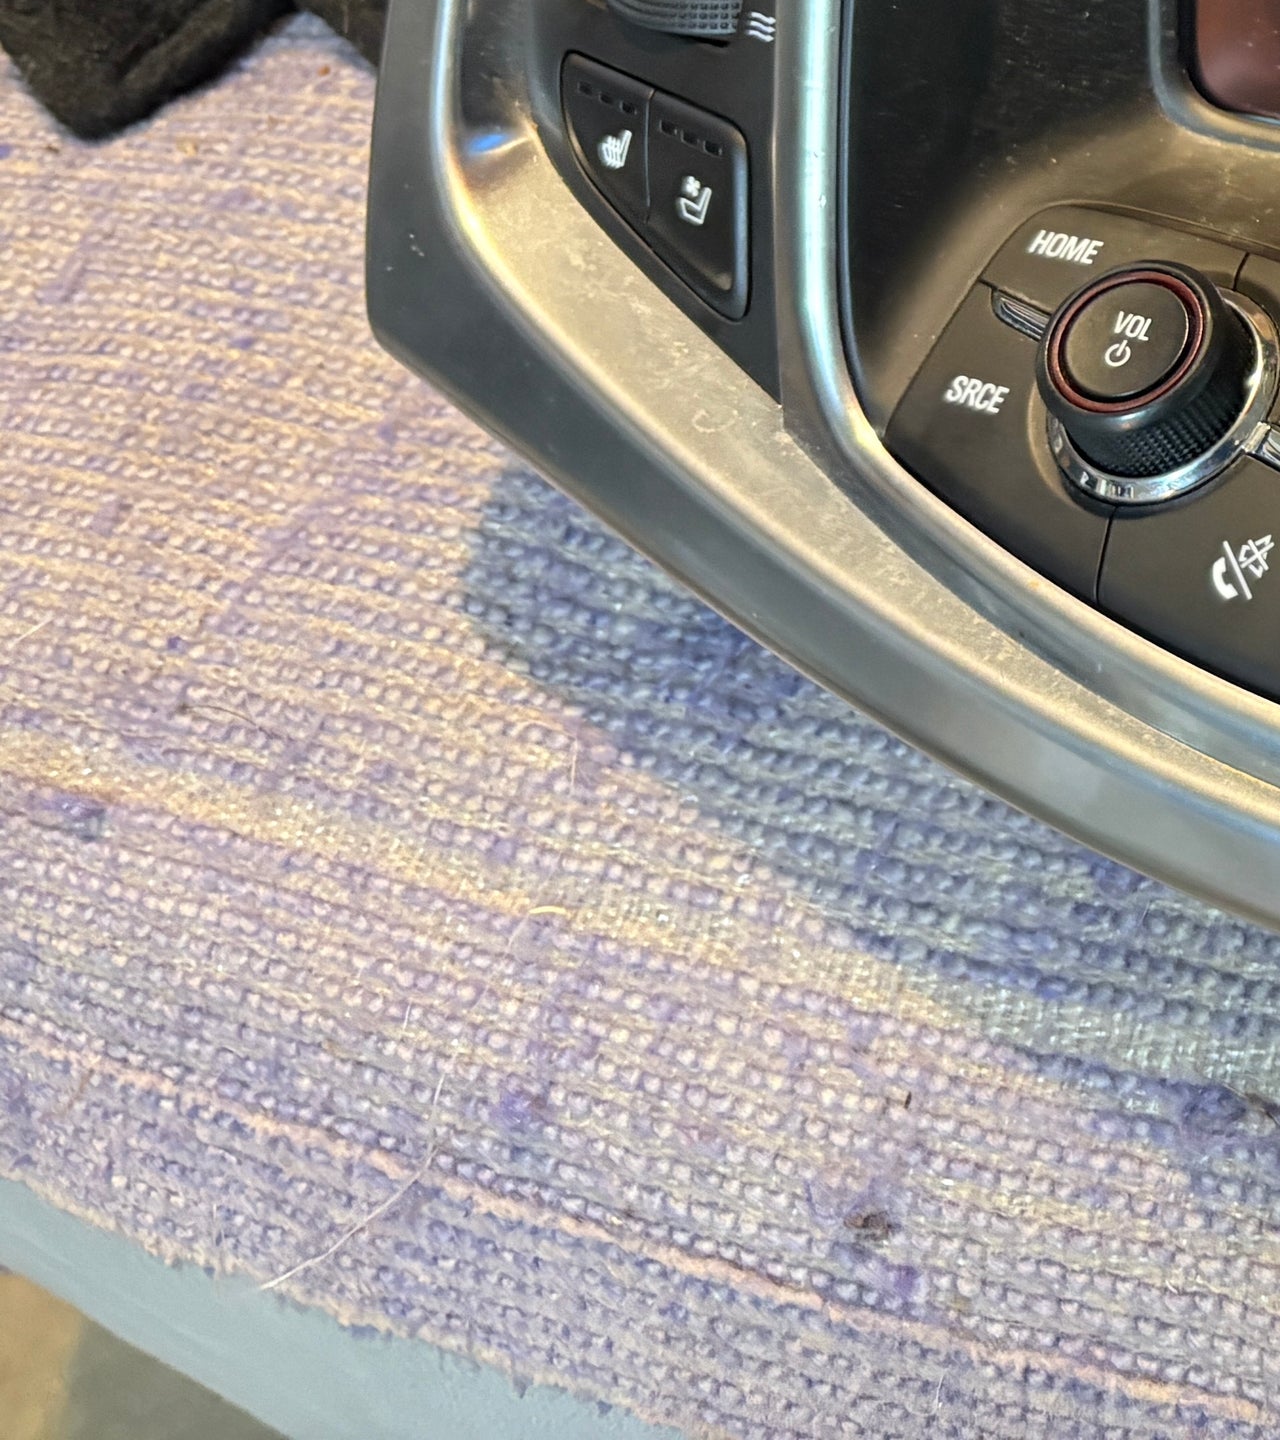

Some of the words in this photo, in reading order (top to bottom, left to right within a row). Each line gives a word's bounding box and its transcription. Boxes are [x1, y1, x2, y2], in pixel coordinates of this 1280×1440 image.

[1027, 229, 1105, 265] HOME
[1111, 310, 1152, 343] VOL
[944, 375, 1010, 415] SRCE
